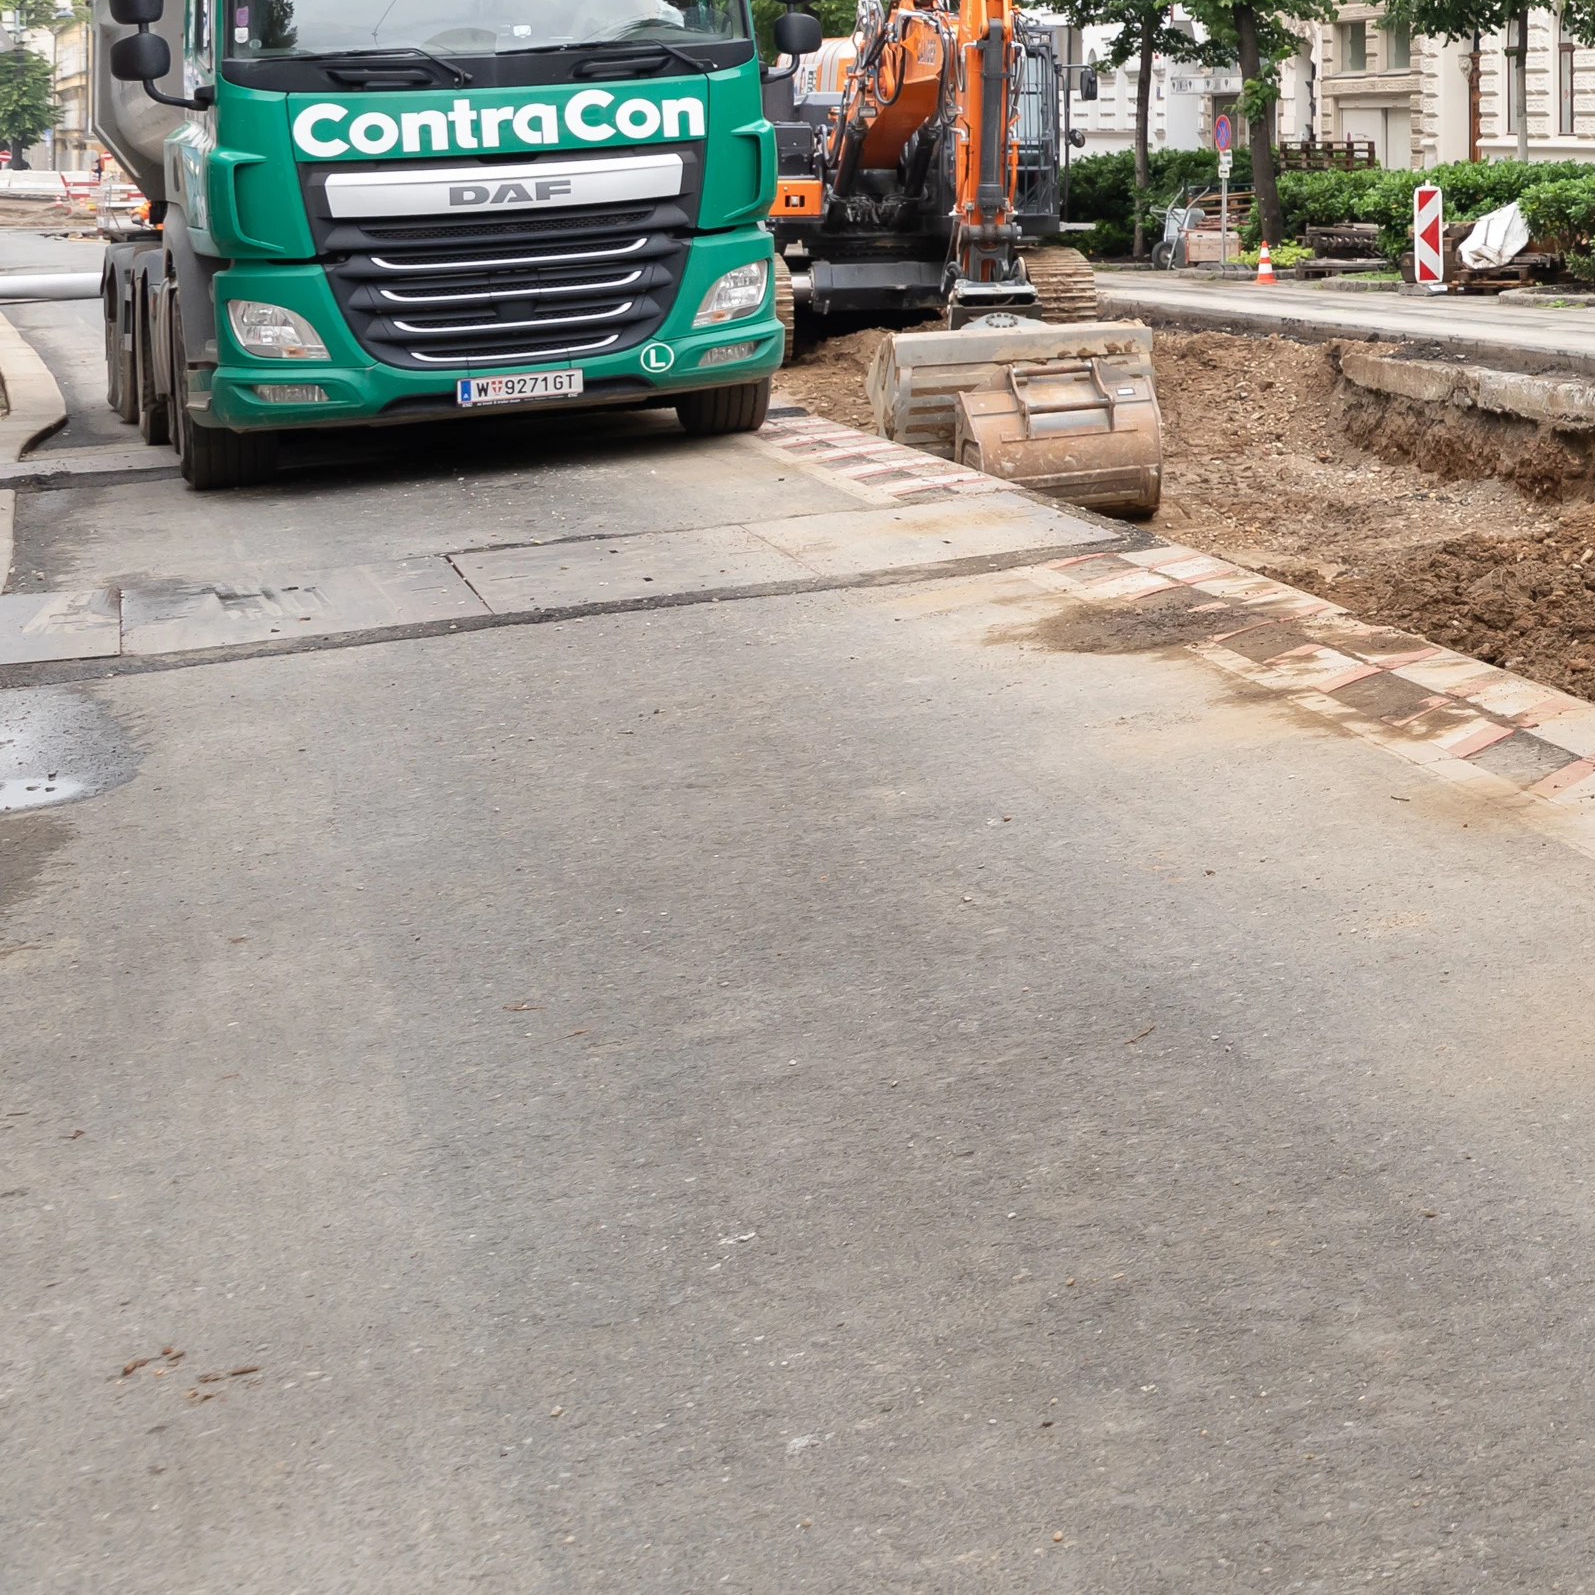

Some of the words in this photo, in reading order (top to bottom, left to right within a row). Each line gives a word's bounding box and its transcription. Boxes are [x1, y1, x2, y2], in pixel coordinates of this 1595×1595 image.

[449, 179, 572, 207] DAF
[649, 348, 666, 368] L
[476, 381, 490, 398] W
